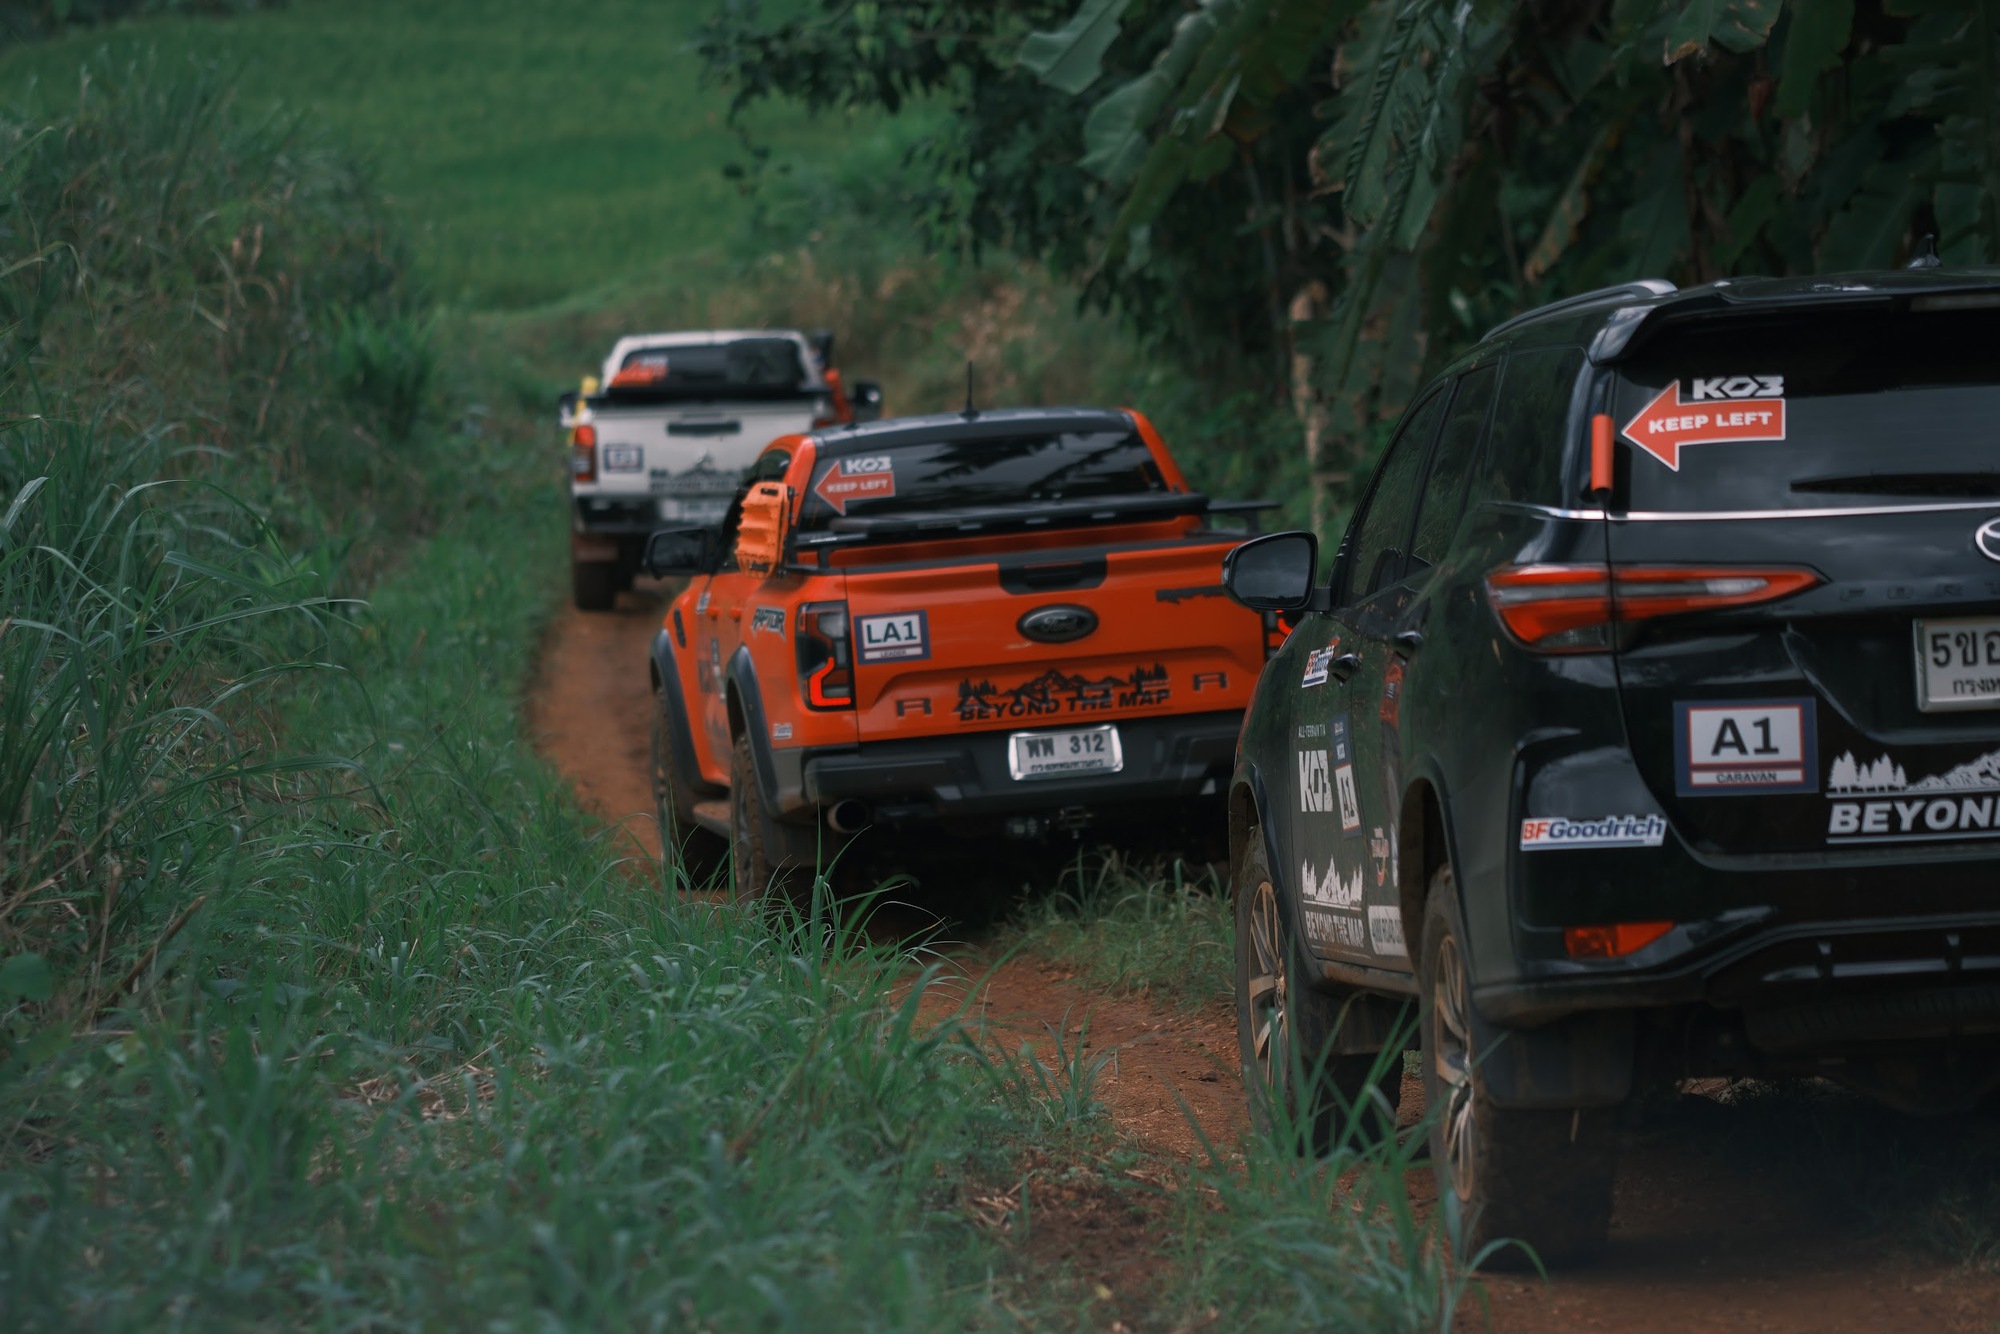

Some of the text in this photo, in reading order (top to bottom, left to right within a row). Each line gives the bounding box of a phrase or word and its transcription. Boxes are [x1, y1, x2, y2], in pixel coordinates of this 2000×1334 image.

[1692, 375, 1784, 399] KO3
[1648, 411, 1772, 433] KEEP LEFT
[846, 456, 892, 473] KO3
[827, 480, 888, 493] KEEP LEFT
[751, 606, 787, 641] RAPTOR
[866, 620, 917, 644] LA1
[959, 688, 1170, 721] BEYOND THE MAP
[1070, 733, 1106, 754] 312
[1711, 717, 1780, 757] A1
[1716, 771, 1777, 784] CARAVAN
[1522, 814, 1664, 841] BFGoodrich
[1828, 798, 2000, 834] BEYON
[1305, 910, 1335, 943] BEYOND
[1333, 915, 1350, 946] THE
[1347, 917, 1365, 948] MAP
